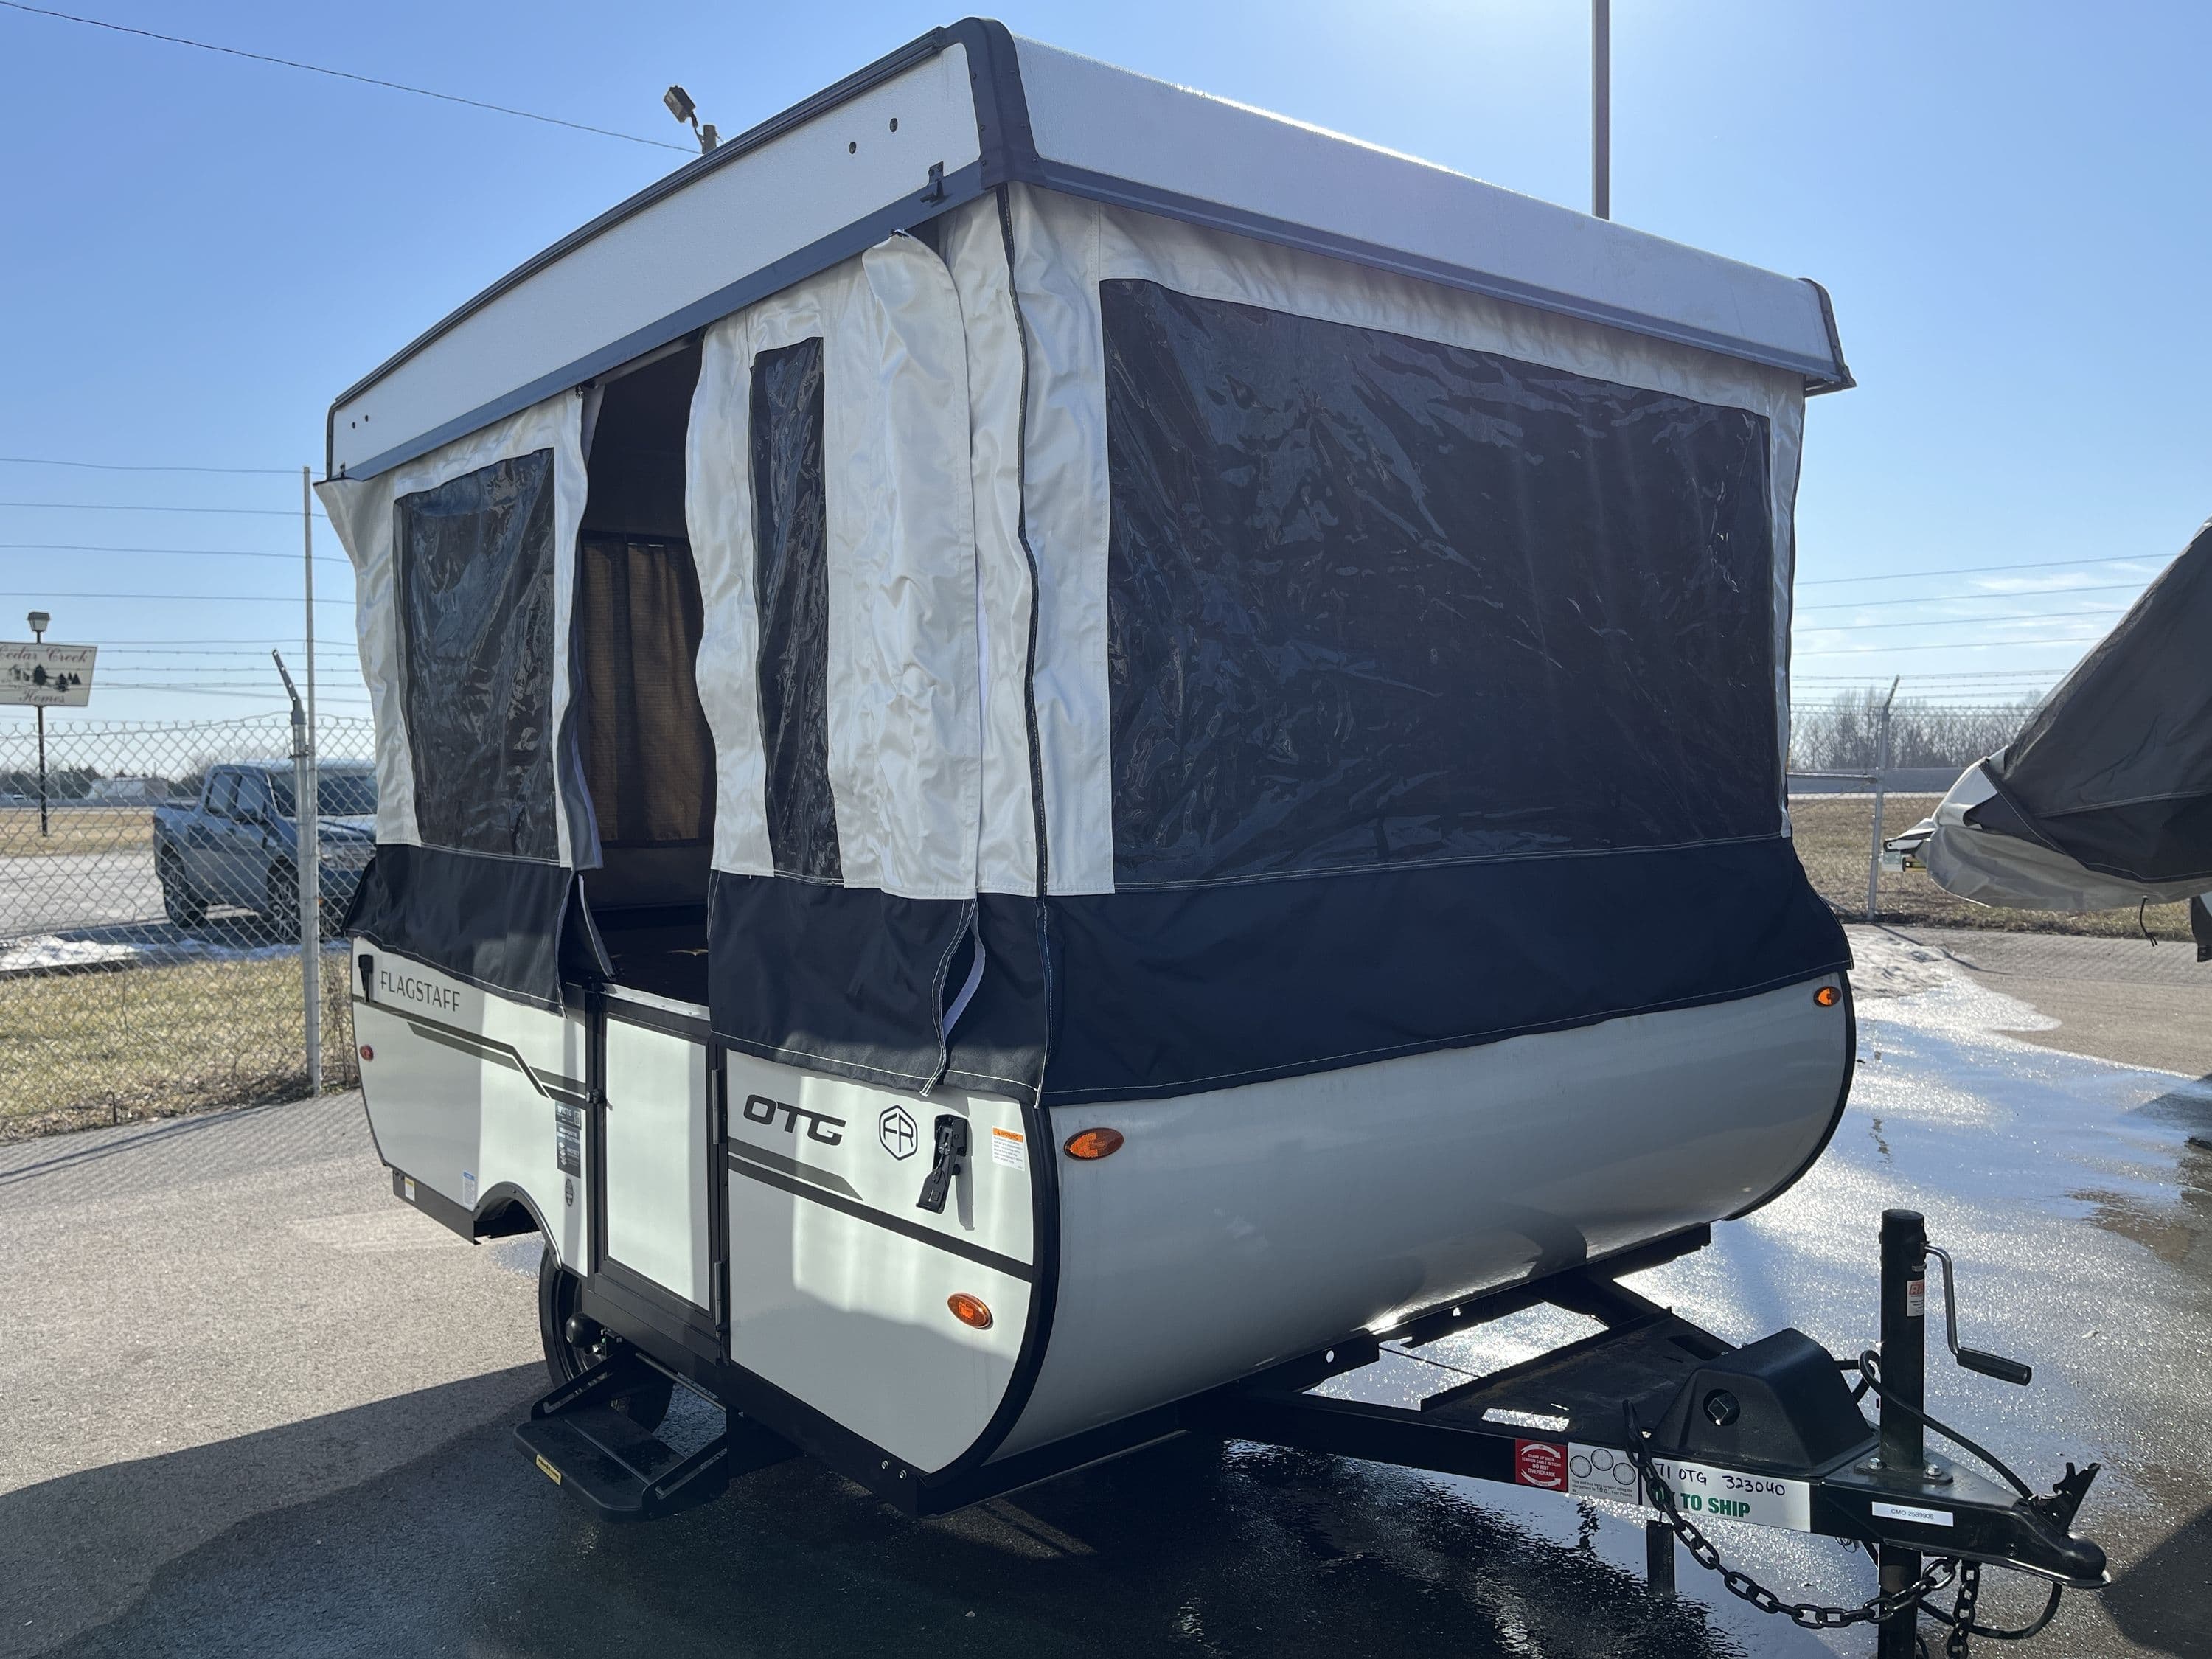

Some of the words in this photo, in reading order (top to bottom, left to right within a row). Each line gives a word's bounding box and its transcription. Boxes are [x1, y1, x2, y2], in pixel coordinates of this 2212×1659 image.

[46, 647, 92, 662] Creek
[19, 689, 65, 703] Homes
[380, 970, 461, 1012] FLAGSTAFF
[743, 1094, 847, 1146] OTG
[1528, 1467, 1556, 1478] OVERCRANK
[1679, 1468, 1707, 1486] OTG
[1722, 1475, 1786, 1496] 323040
[1680, 1492, 1703, 1511] TO
[1708, 1497, 1750, 1518] SHIP
[1891, 1508, 1907, 1516] CMO
